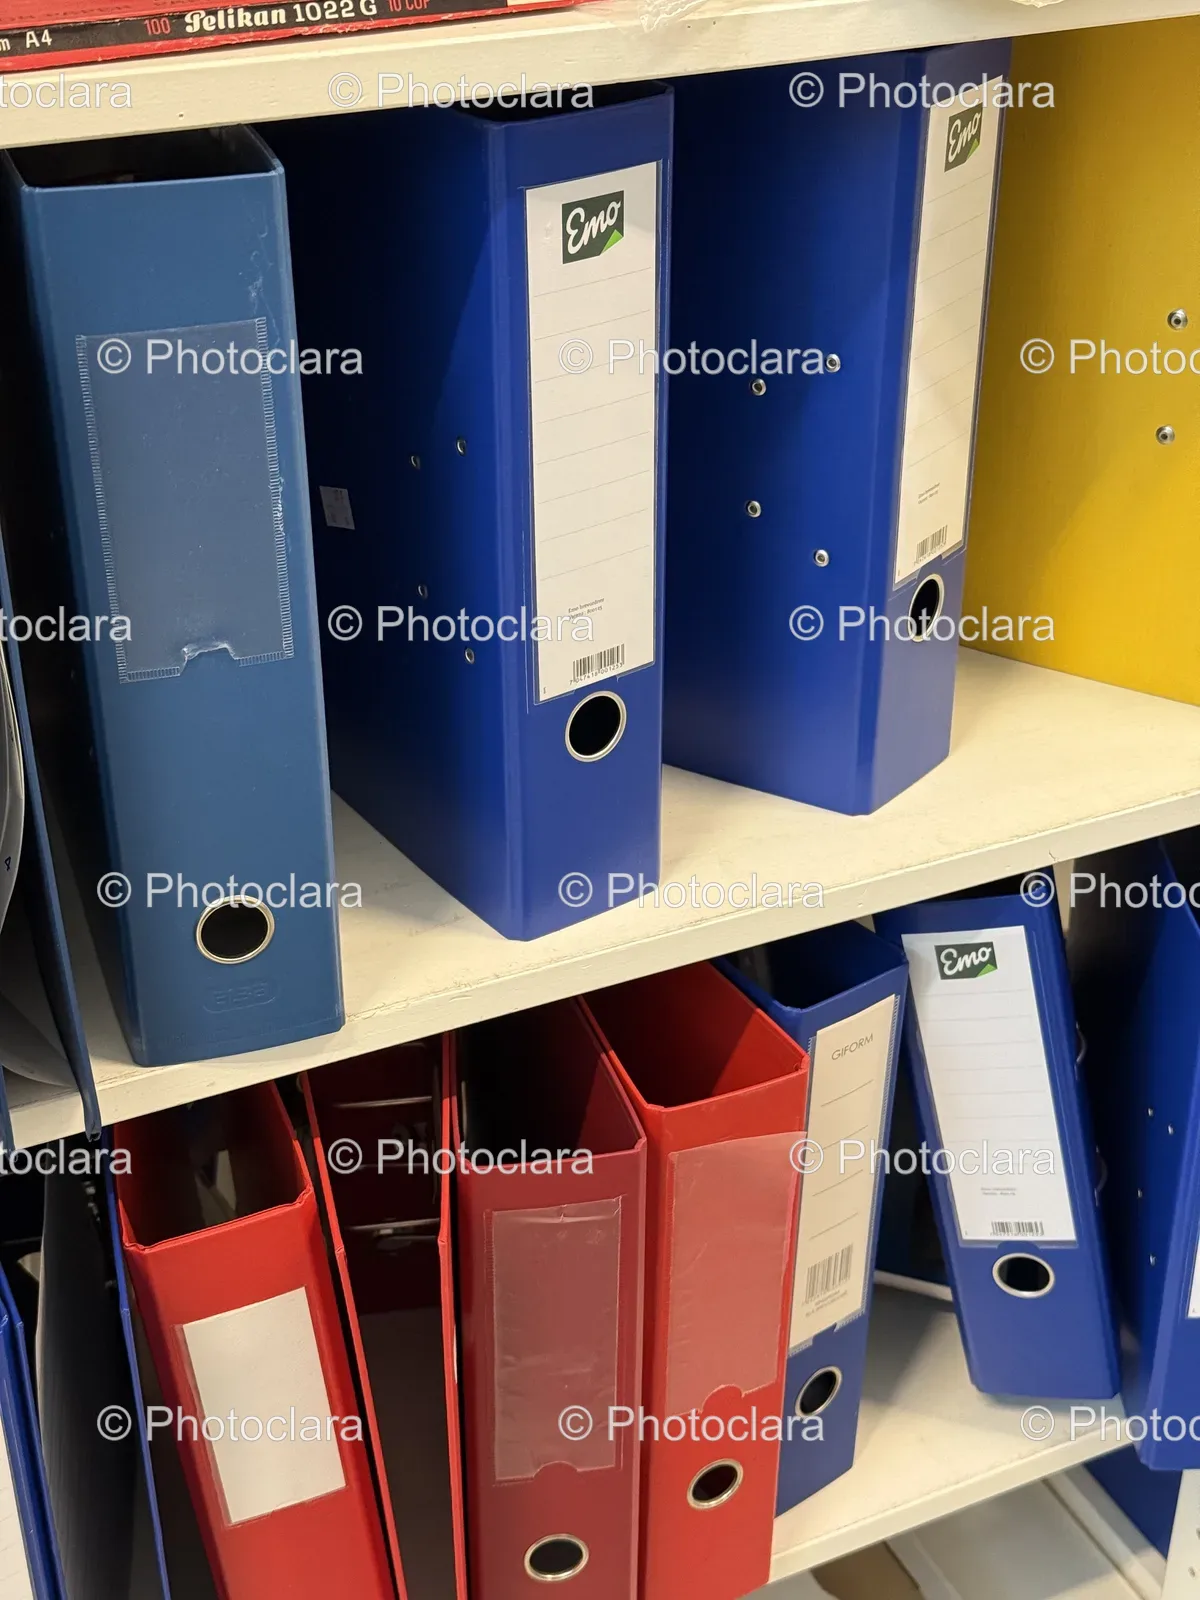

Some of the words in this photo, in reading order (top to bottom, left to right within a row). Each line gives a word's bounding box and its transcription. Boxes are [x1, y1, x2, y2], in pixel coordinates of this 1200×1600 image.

[143, 17, 171, 36] 100
[184, 8, 287, 33] Pelikan
[293, 0, 356, 23] 1022
[359, 0, 378, 16] G
[26, 29, 53, 49] A4
[948, 112, 982, 163] Emo
[566, 201, 622, 255] Emo
[940, 946, 992, 976] Emo
[831, 1033, 874, 1061] GIFORM
